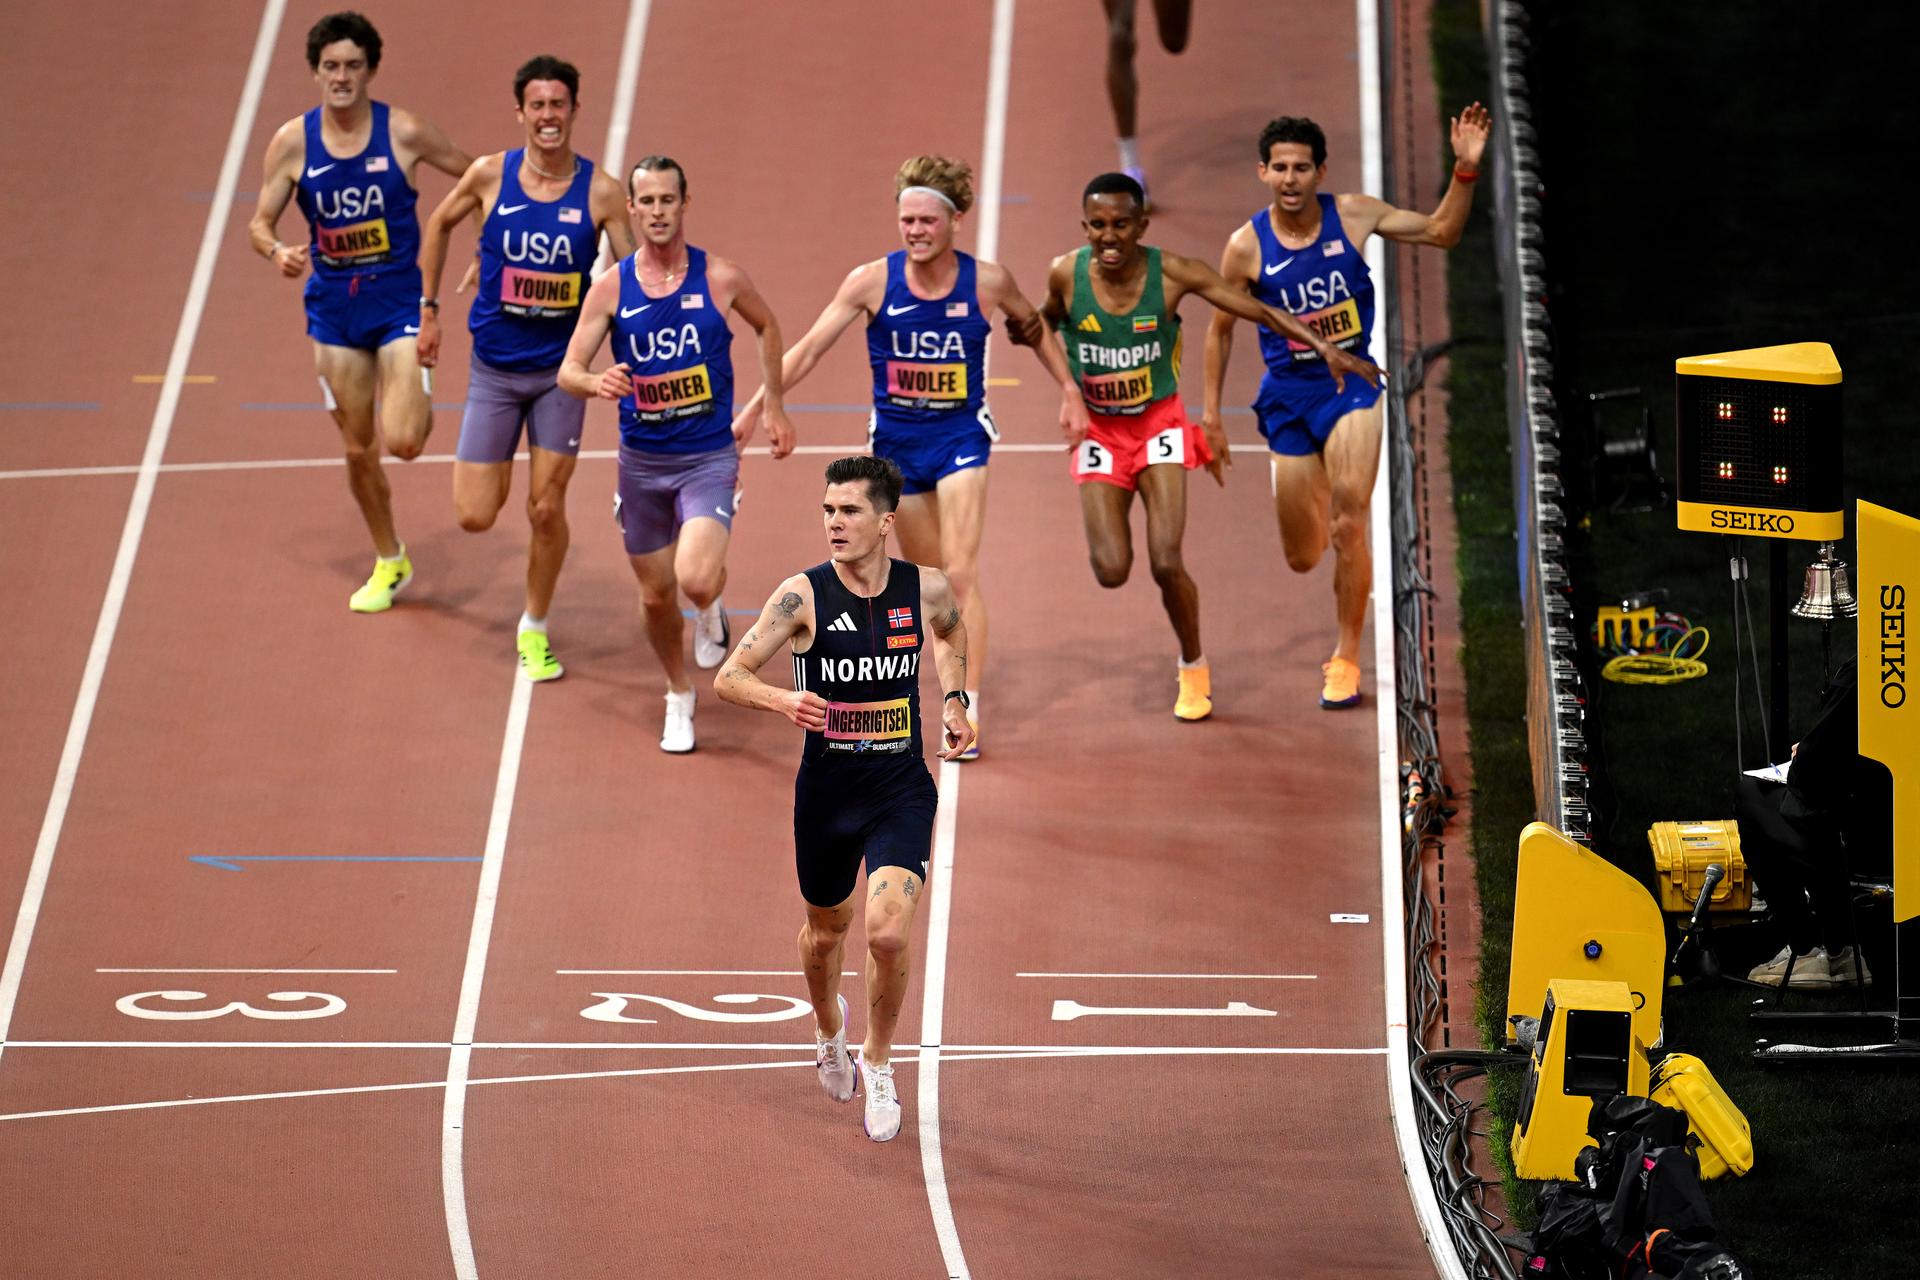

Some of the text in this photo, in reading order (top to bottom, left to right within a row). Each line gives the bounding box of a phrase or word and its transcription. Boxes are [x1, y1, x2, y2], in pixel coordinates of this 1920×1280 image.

[315, 184, 385, 219] USA
[502, 229, 574, 265] USA
[513, 275, 571, 301] YOUNG
[1280, 270, 1351, 314] USA
[1308, 309, 1352, 337] SHER
[629, 322, 701, 362] USA
[891, 330, 966, 359] USA
[1078, 341, 1162, 369] ETHIOPIA
[636, 374, 705, 405] HOCKER
[897, 369, 957, 392] WOLFE
[1087, 446, 1102, 468] 5
[1159, 435, 1173, 457] 5
[1711, 509, 1795, 533] SEIKO
[1880, 584, 1906, 709] SEIKO
[821, 652, 919, 682] NORWAY
[827, 706, 908, 733] INGEBRIGTSEN
[829, 742, 854, 751] ULTIMATE
[872, 742, 898, 751] BUDAPEST
[115, 990, 347, 1021] 3
[579, 992, 813, 1023] 2
[1051, 1000, 1278, 1021] 1
